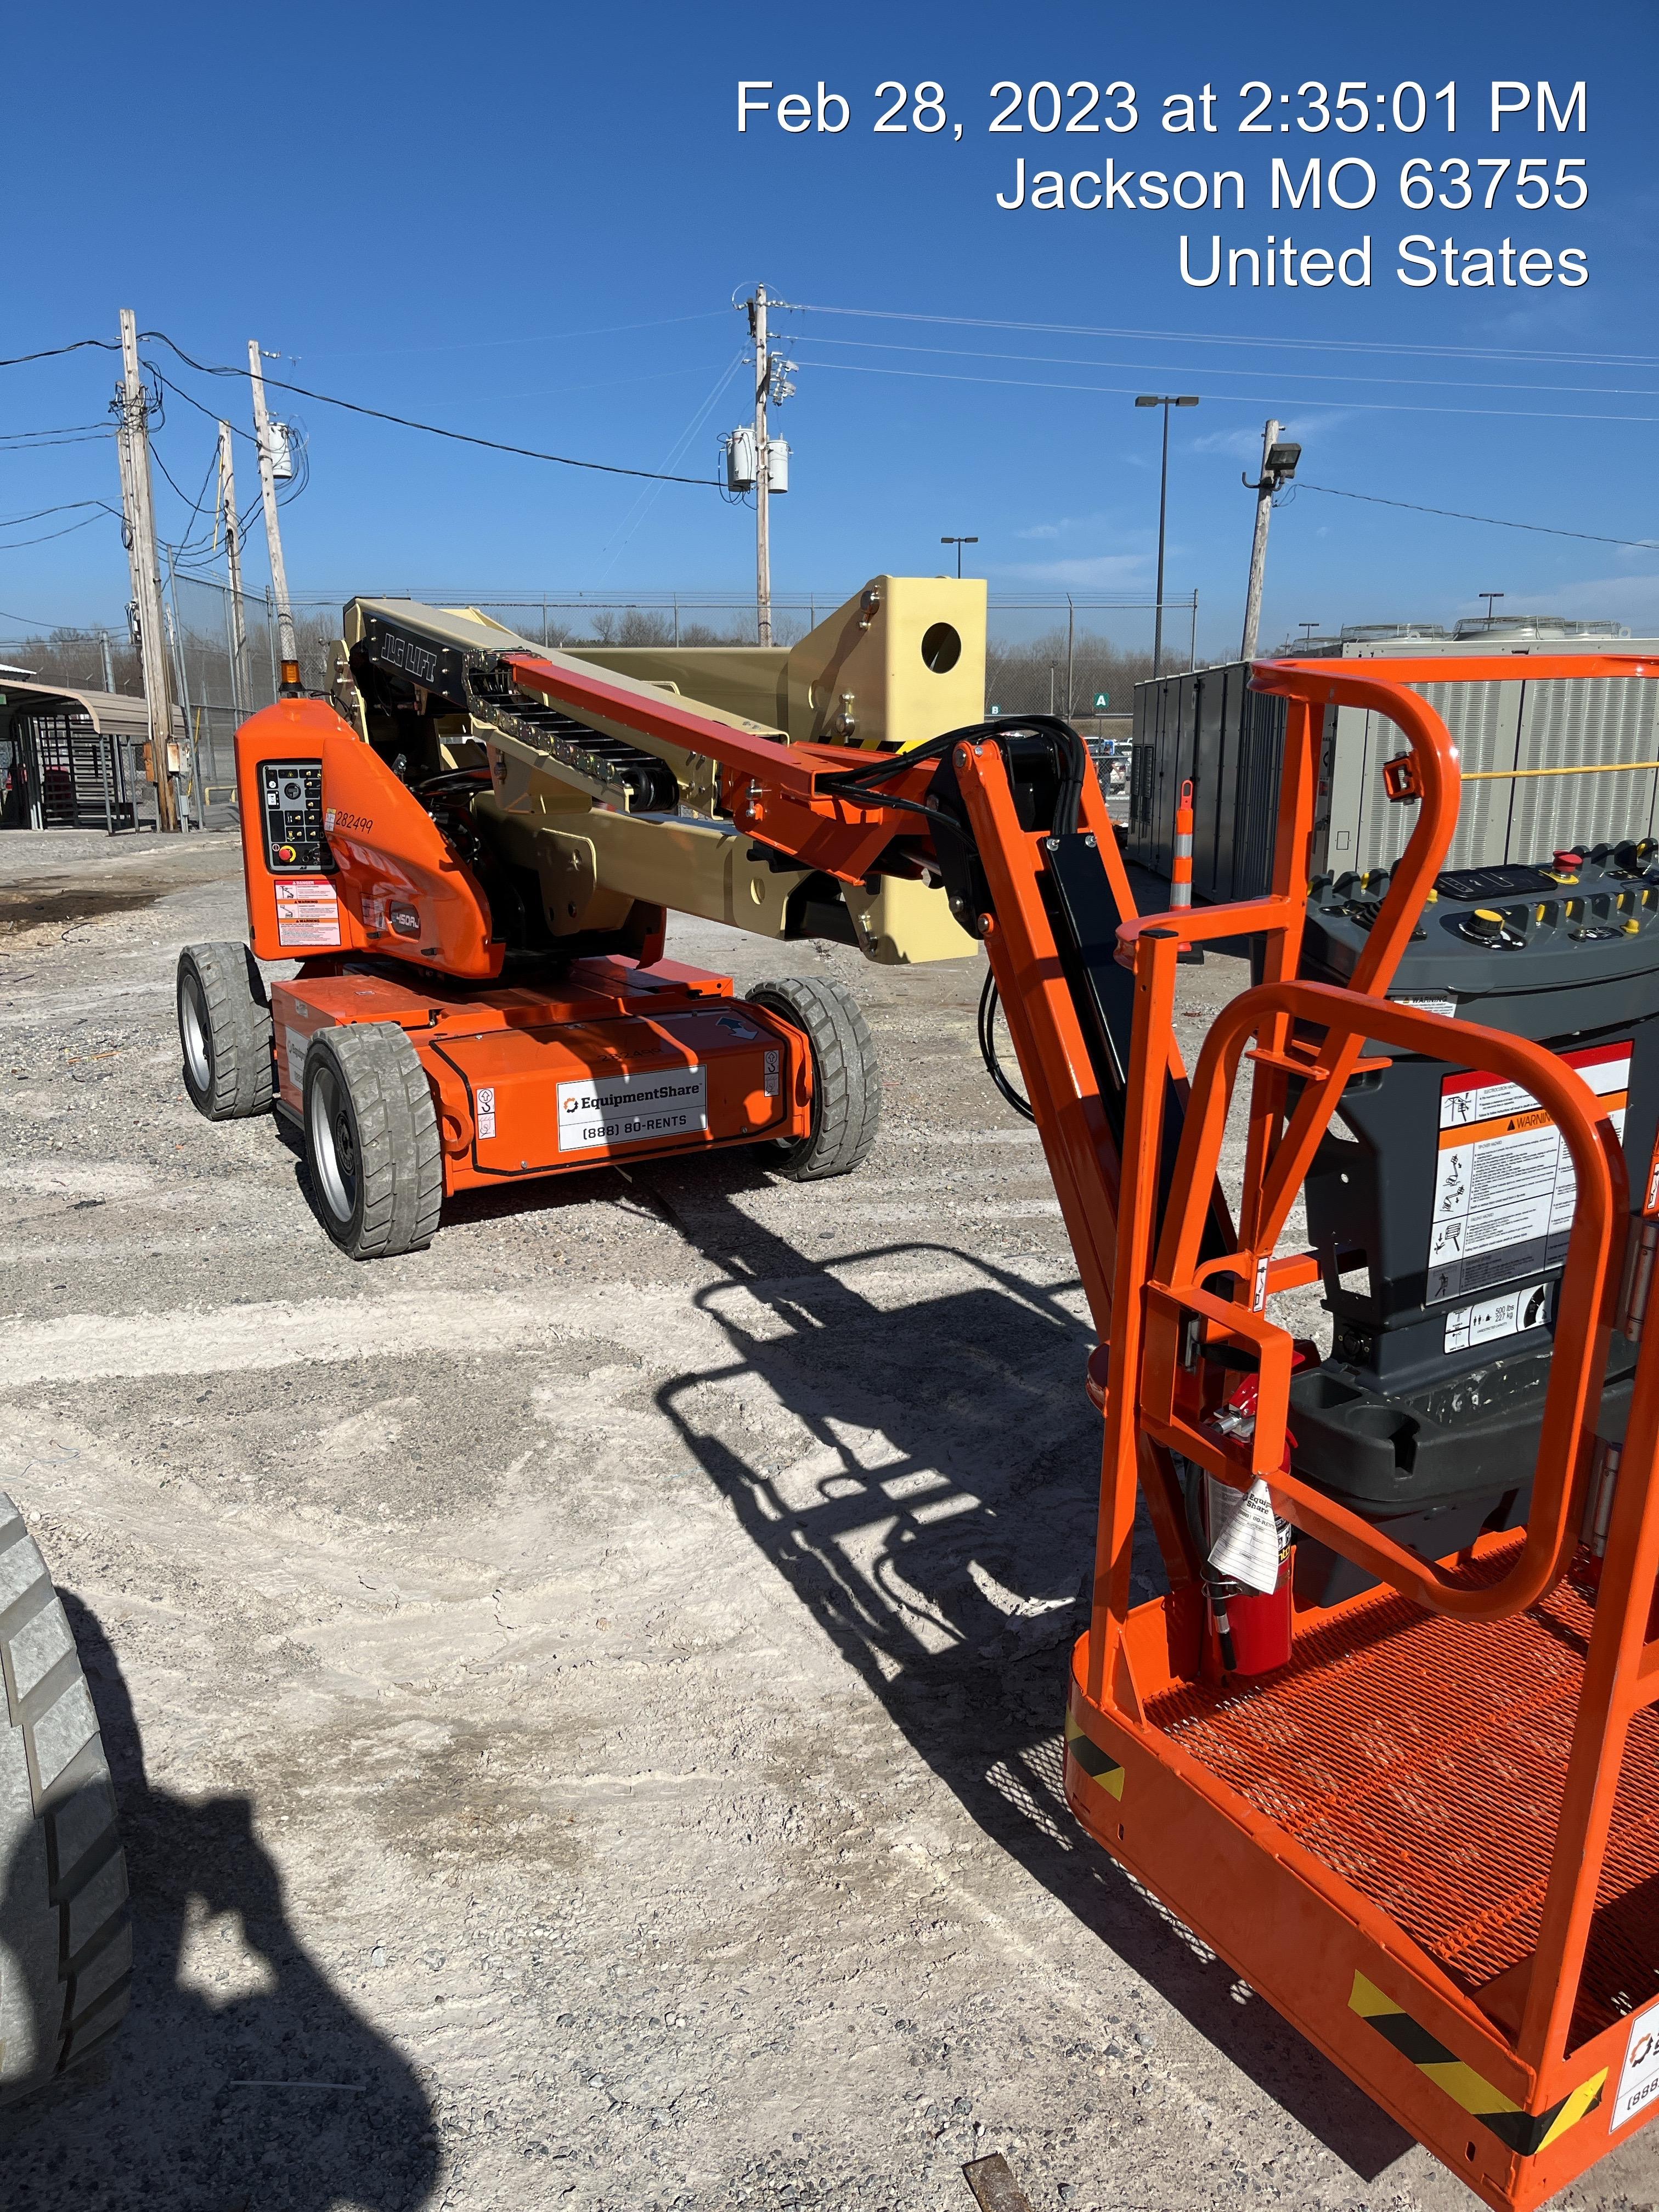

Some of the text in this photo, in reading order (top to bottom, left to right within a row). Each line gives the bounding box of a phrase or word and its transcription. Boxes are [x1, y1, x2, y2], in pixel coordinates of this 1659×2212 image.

[381, 633, 437, 682] JLG LIFT
[1096, 695, 1106, 706] A
[991, 706, 999, 714] B
[335, 811, 373, 834] 282499
[597, 1048, 662, 1062] 282499
[1516, 1111, 1551, 1129] WARNIN
[583, 1115, 687, 1140] (888) 80-RENTS
[1495, 1306, 1505, 1315] 500
[1495, 1313, 1505, 1322] 227
[1246, 1500, 1269, 1514] Share
[1249, 1493, 1272, 1508] Equip
[1627, 2078, 1659, 2111] (888
